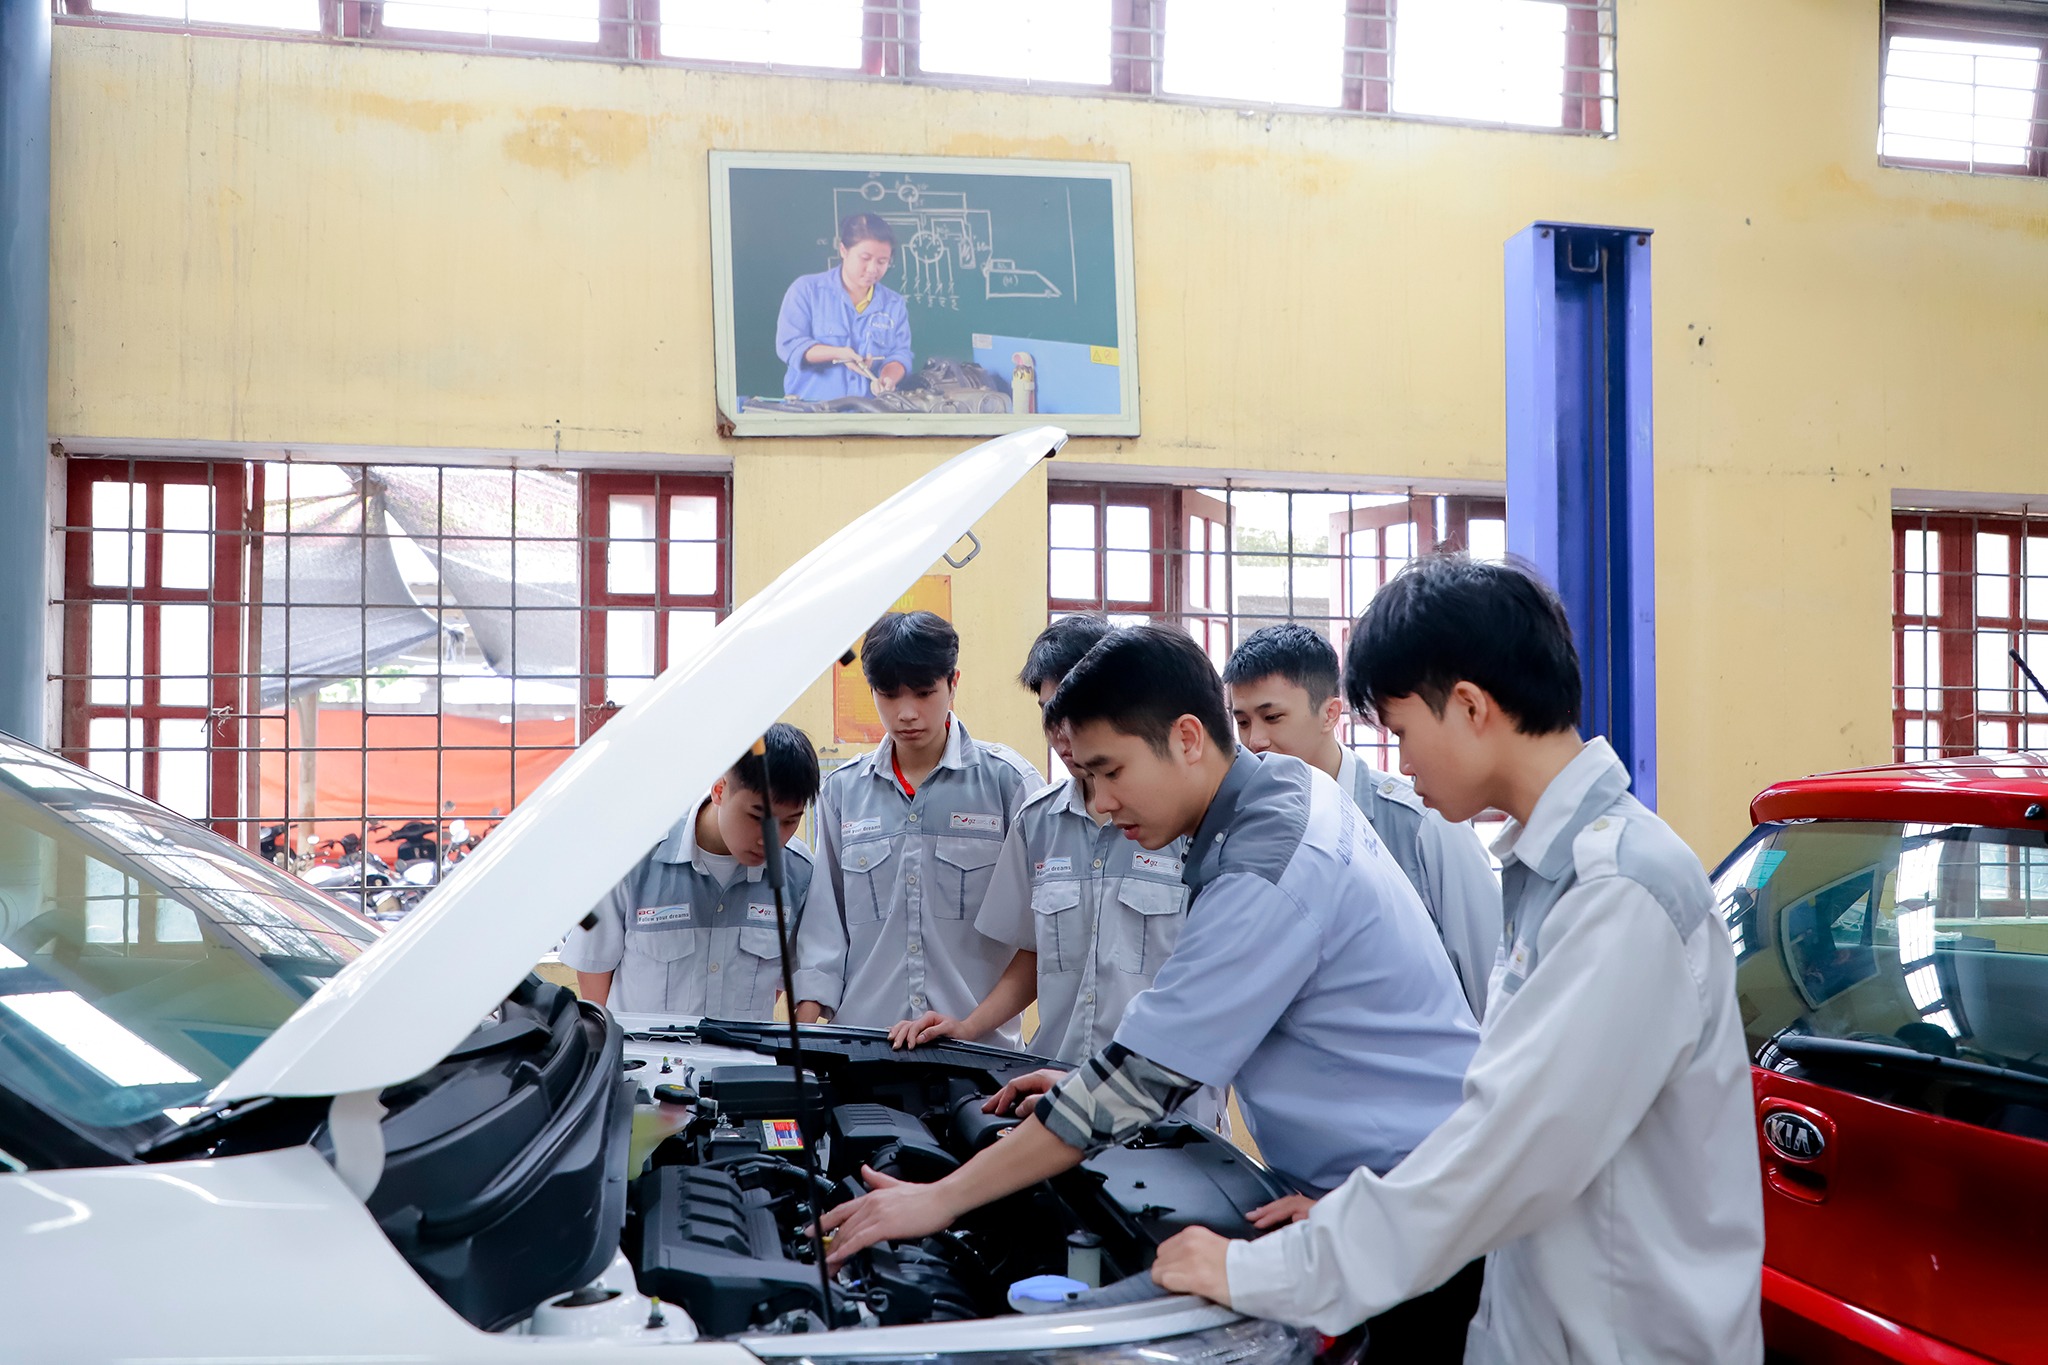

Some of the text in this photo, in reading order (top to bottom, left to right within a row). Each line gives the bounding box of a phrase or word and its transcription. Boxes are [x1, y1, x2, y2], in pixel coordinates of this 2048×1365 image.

[656, 914, 668, 922] your
[669, 911, 689, 919] dreams
[1770, 1117, 1811, 1154] KIA
